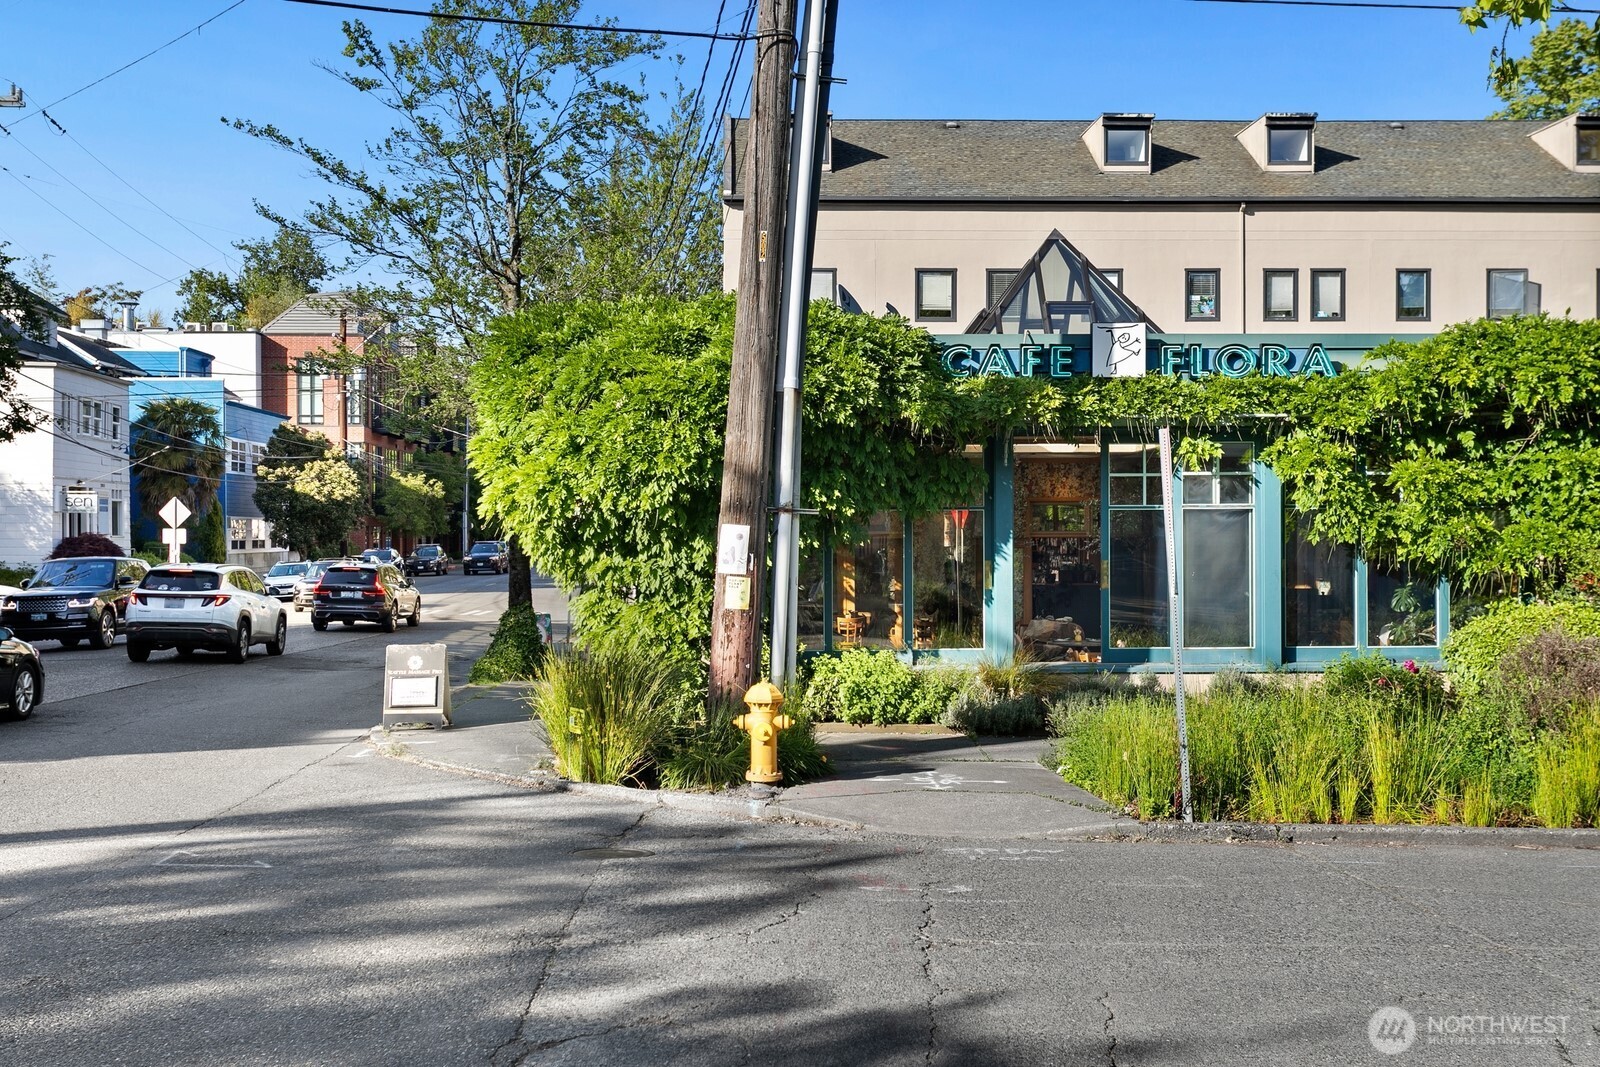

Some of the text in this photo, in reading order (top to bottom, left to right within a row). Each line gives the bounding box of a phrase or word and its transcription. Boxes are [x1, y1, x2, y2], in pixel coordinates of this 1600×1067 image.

[941, 343, 1338, 379] CAFE FLORA
[65, 497, 93, 507] sen
